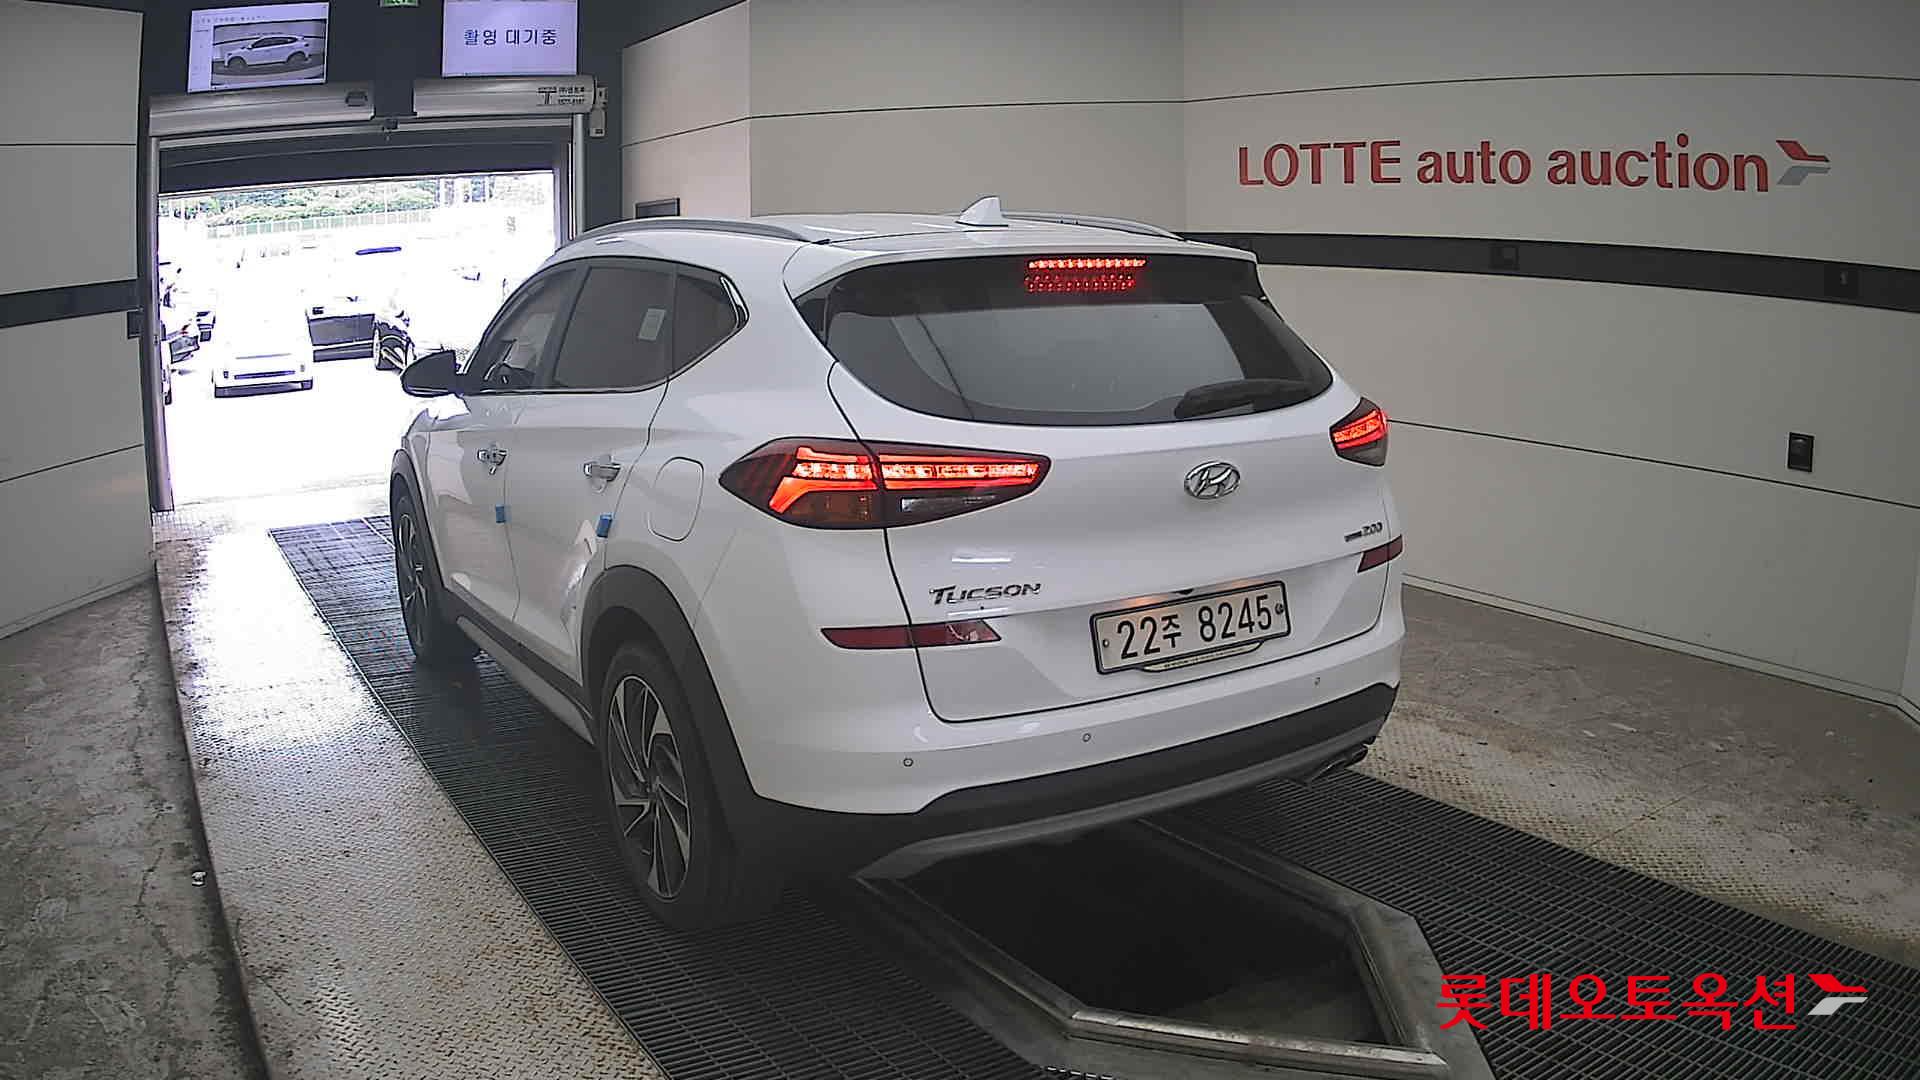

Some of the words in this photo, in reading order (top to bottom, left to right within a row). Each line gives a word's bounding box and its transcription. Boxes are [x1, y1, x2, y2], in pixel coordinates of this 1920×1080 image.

[464, 29, 497, 46] 촬영
[505, 29, 557, 46] 대기중
[1239, 139, 1402, 187] LOTTE
[1416, 140, 1532, 185] auto
[1547, 132, 1769, 193] auction
[928, 583, 1042, 605] TUCSON
[1117, 614, 1181, 660] 22주
[1197, 594, 1272, 643] 8245
